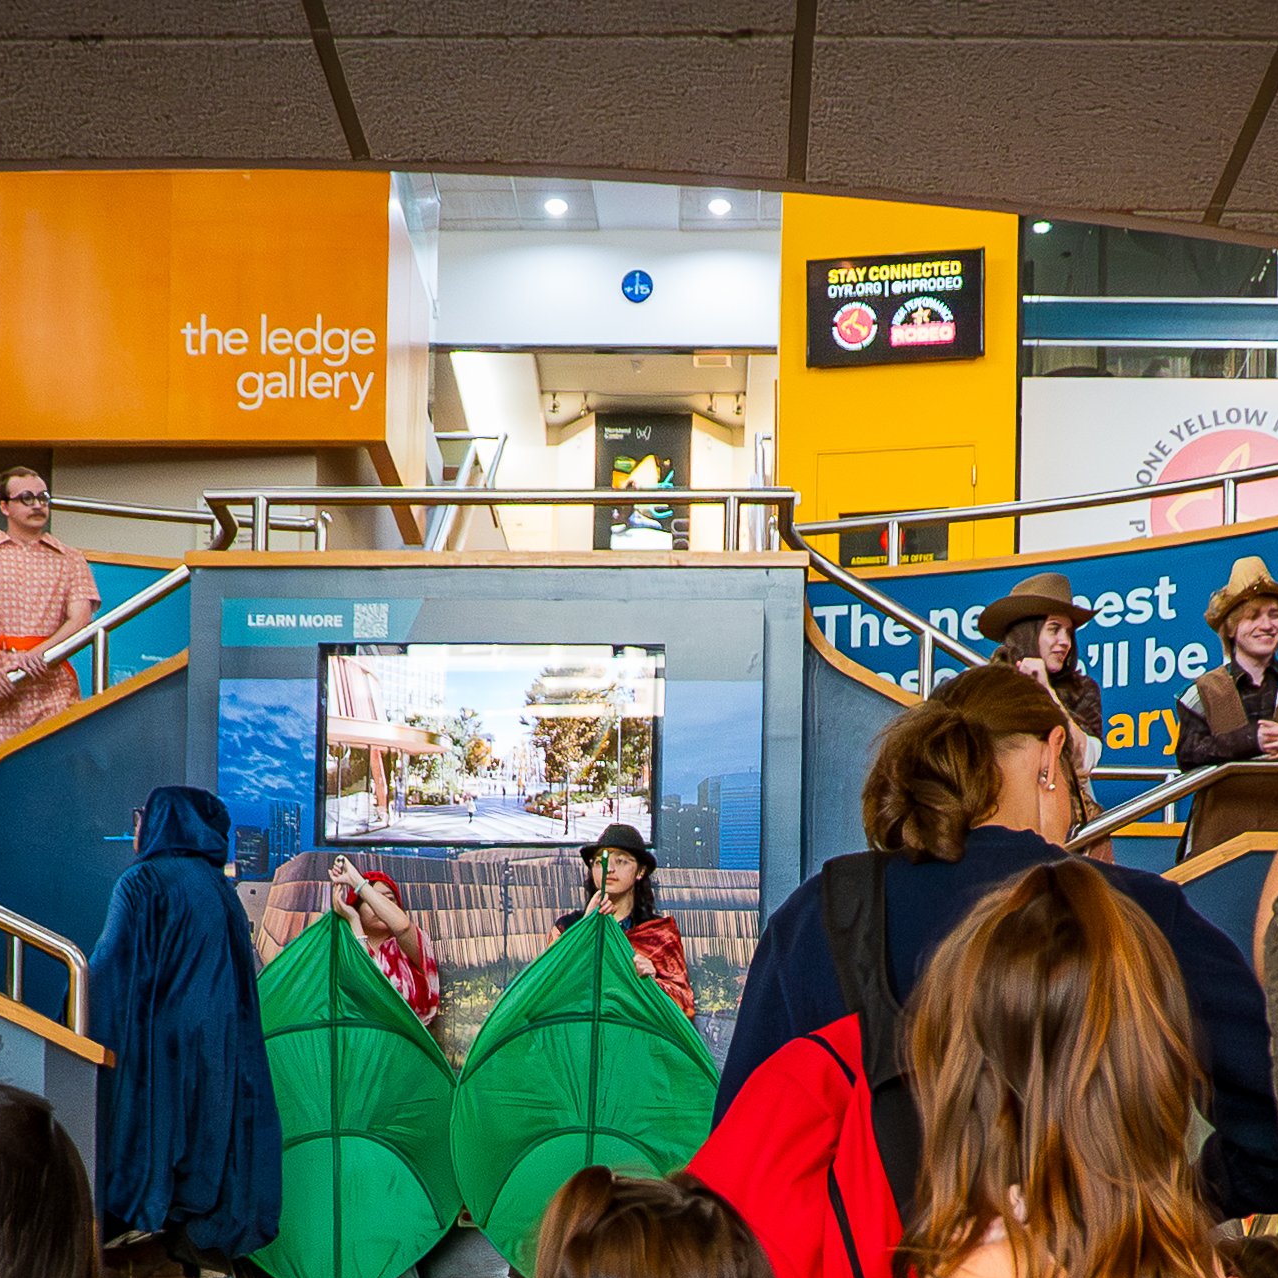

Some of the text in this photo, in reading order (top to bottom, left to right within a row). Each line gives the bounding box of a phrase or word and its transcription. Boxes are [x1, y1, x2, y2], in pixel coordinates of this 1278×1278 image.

[828, 260, 962, 284] STAY CONNECTED
[828, 275, 963, 298] OYR.ORG @HPRODEO
[180, 313, 376, 367] the ledge
[891, 325, 953, 343] RODEO
[236, 357, 375, 411] gallery
[1136, 440, 1172, 486] ONE
[1169, 407, 1268, 442] YELLOW
[247, 613, 343, 628] LEARN MORE
[812, 604, 912, 649] The
[1073, 575, 1177, 632] est
[1077, 641, 1129, 689] 'll
[1145, 637, 1209, 685] be
[1106, 708, 1181, 756] ary
